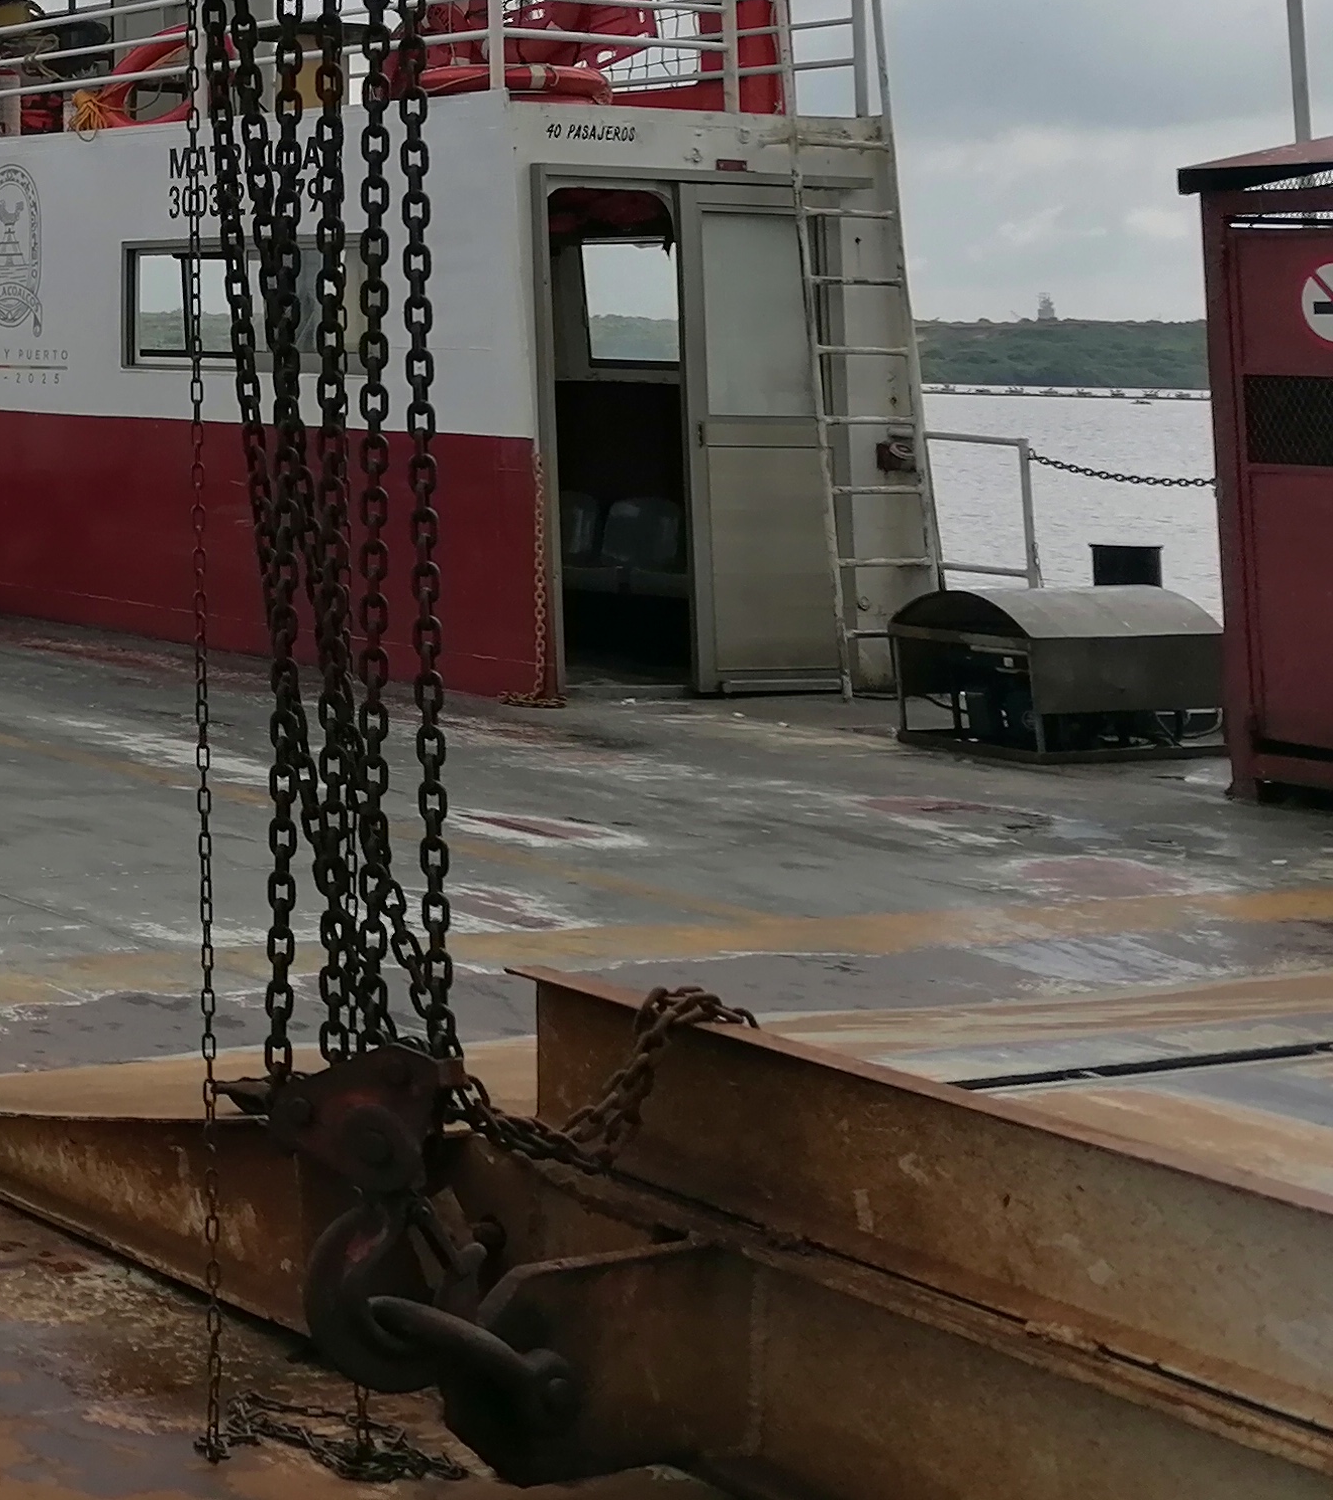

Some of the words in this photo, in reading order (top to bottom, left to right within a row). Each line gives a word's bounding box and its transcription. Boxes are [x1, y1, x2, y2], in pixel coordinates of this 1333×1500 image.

[546, 122, 562, 139] 40
[567, 123, 636, 142] PASAJEROS
[3, 349, 11, 360] Y
[18, 349, 69, 361] PUERTO
